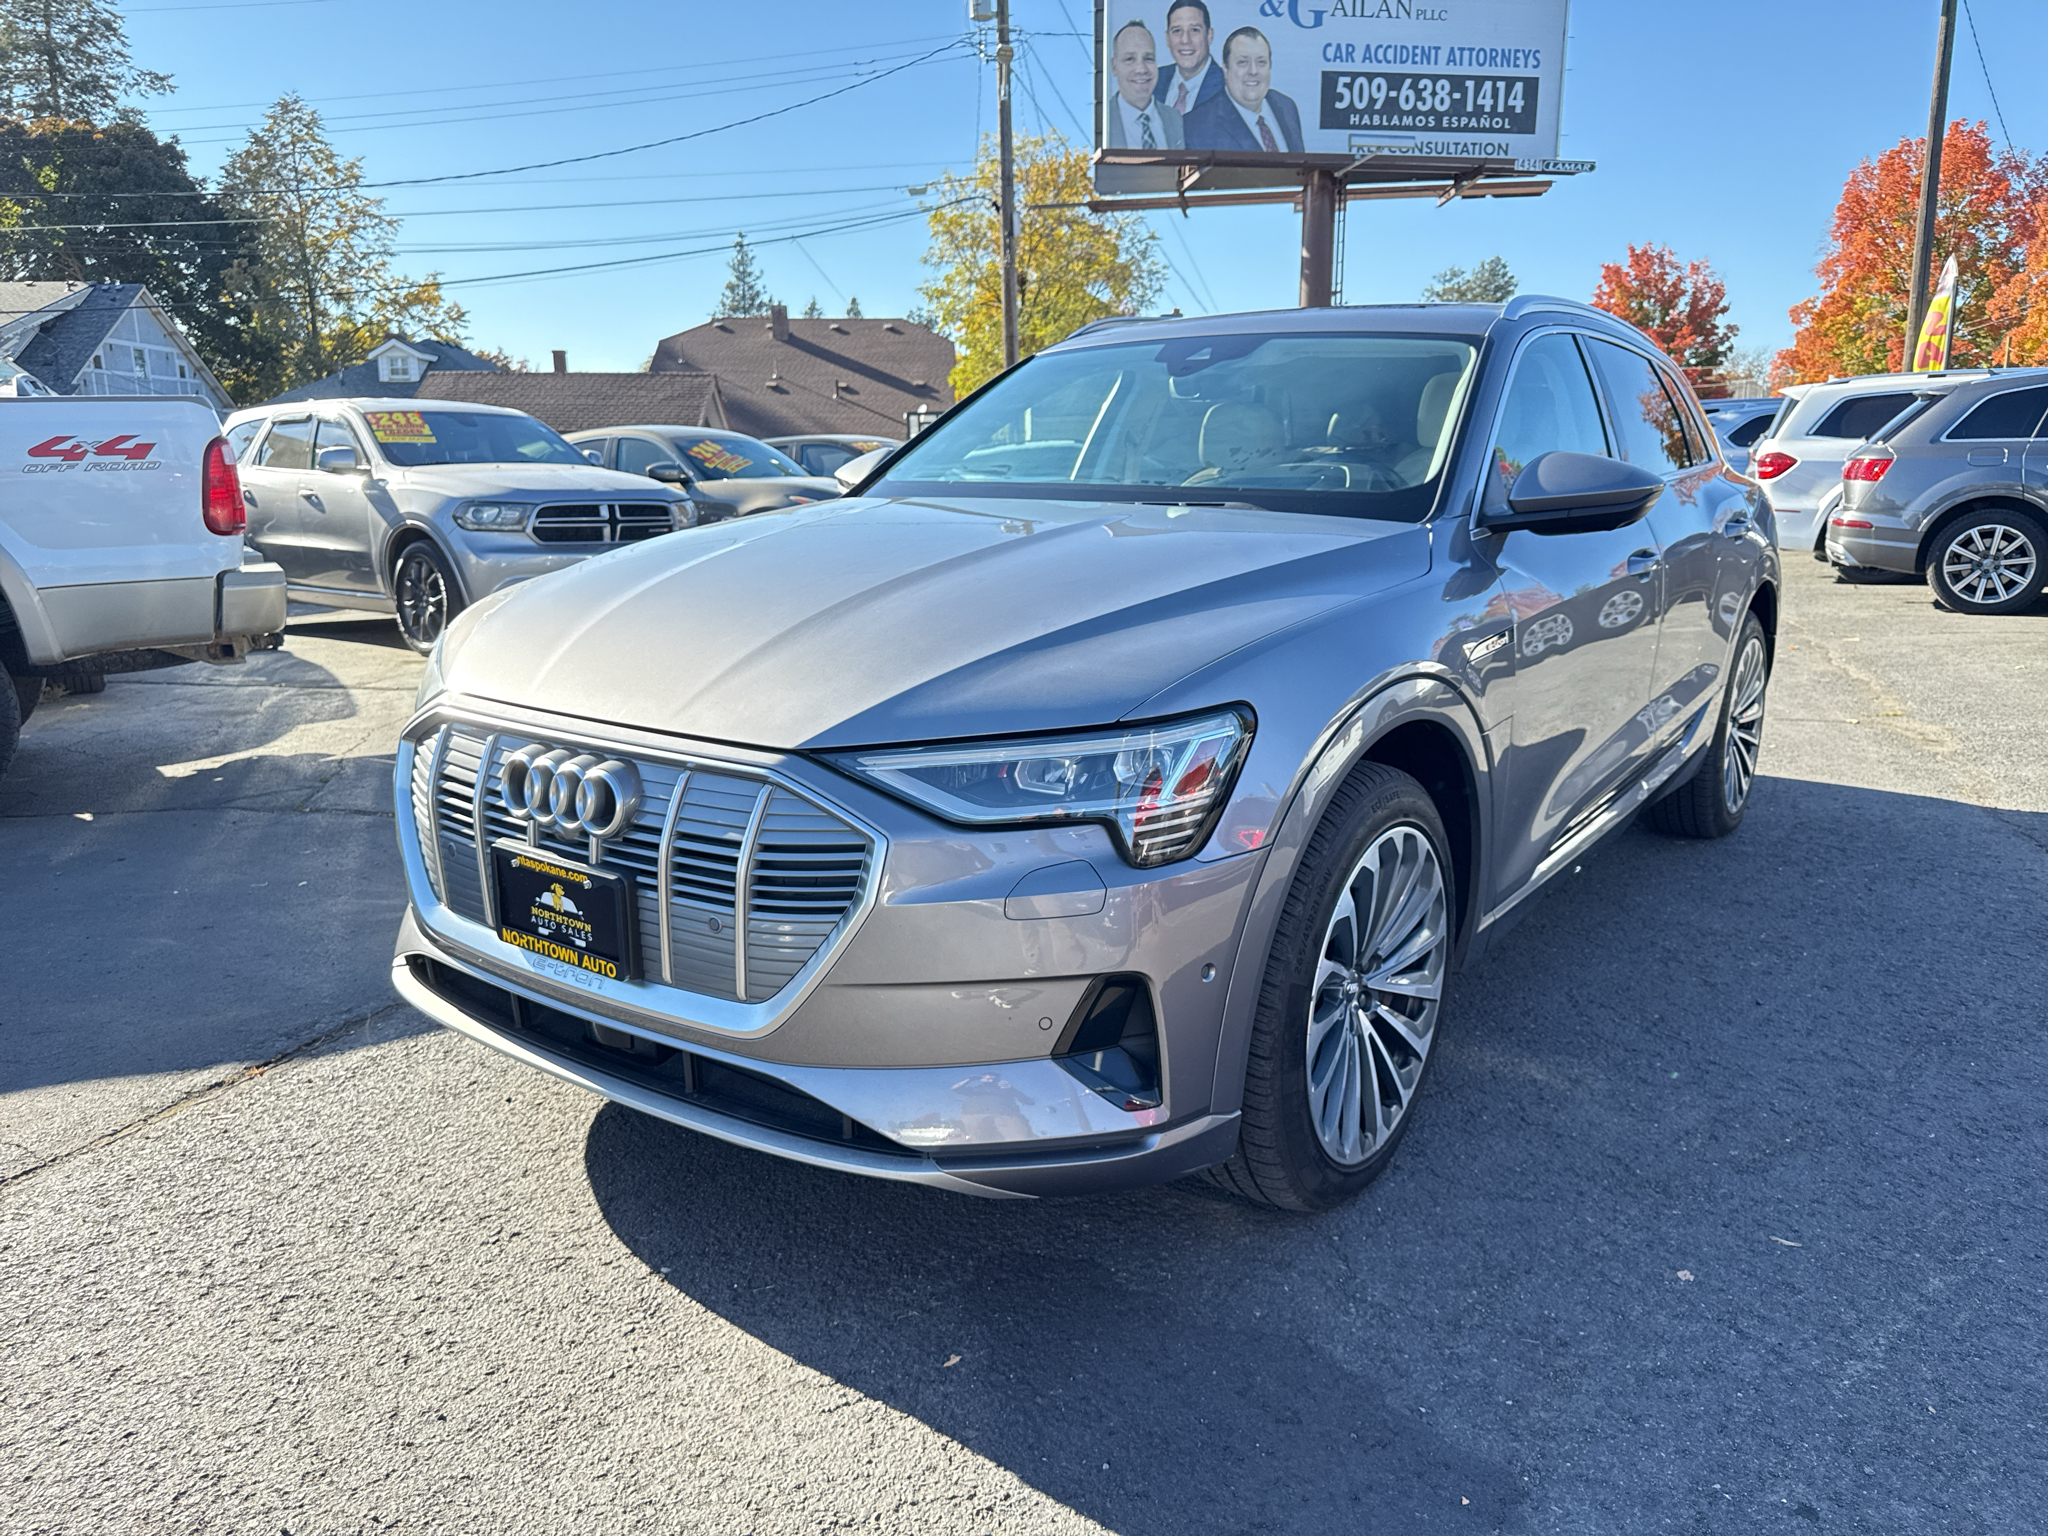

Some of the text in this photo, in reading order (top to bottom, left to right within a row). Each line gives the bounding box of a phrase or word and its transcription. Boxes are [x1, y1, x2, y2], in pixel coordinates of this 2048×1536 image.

[1415, 9, 1448, 21] PLLC
[1322, 42, 1541, 69] CAR ACCIDENT ATTORNEYS
[1334, 76, 1525, 114] 509-638-1414
[1350, 113, 1511, 129] HABLAMOS ESPAÑOL
[1549, 162, 1591, 172] LAMAR
[22, 461, 162, 474] OFF ROAD
[517, 855, 588, 883] ntaspokane.com
[531, 906, 592, 932] NORTHTOWN
[531, 915, 593, 941] AUTO SALES
[502, 928, 617, 978] NORTHTOWN AUTO
[532, 955, 606, 989] e-tron
